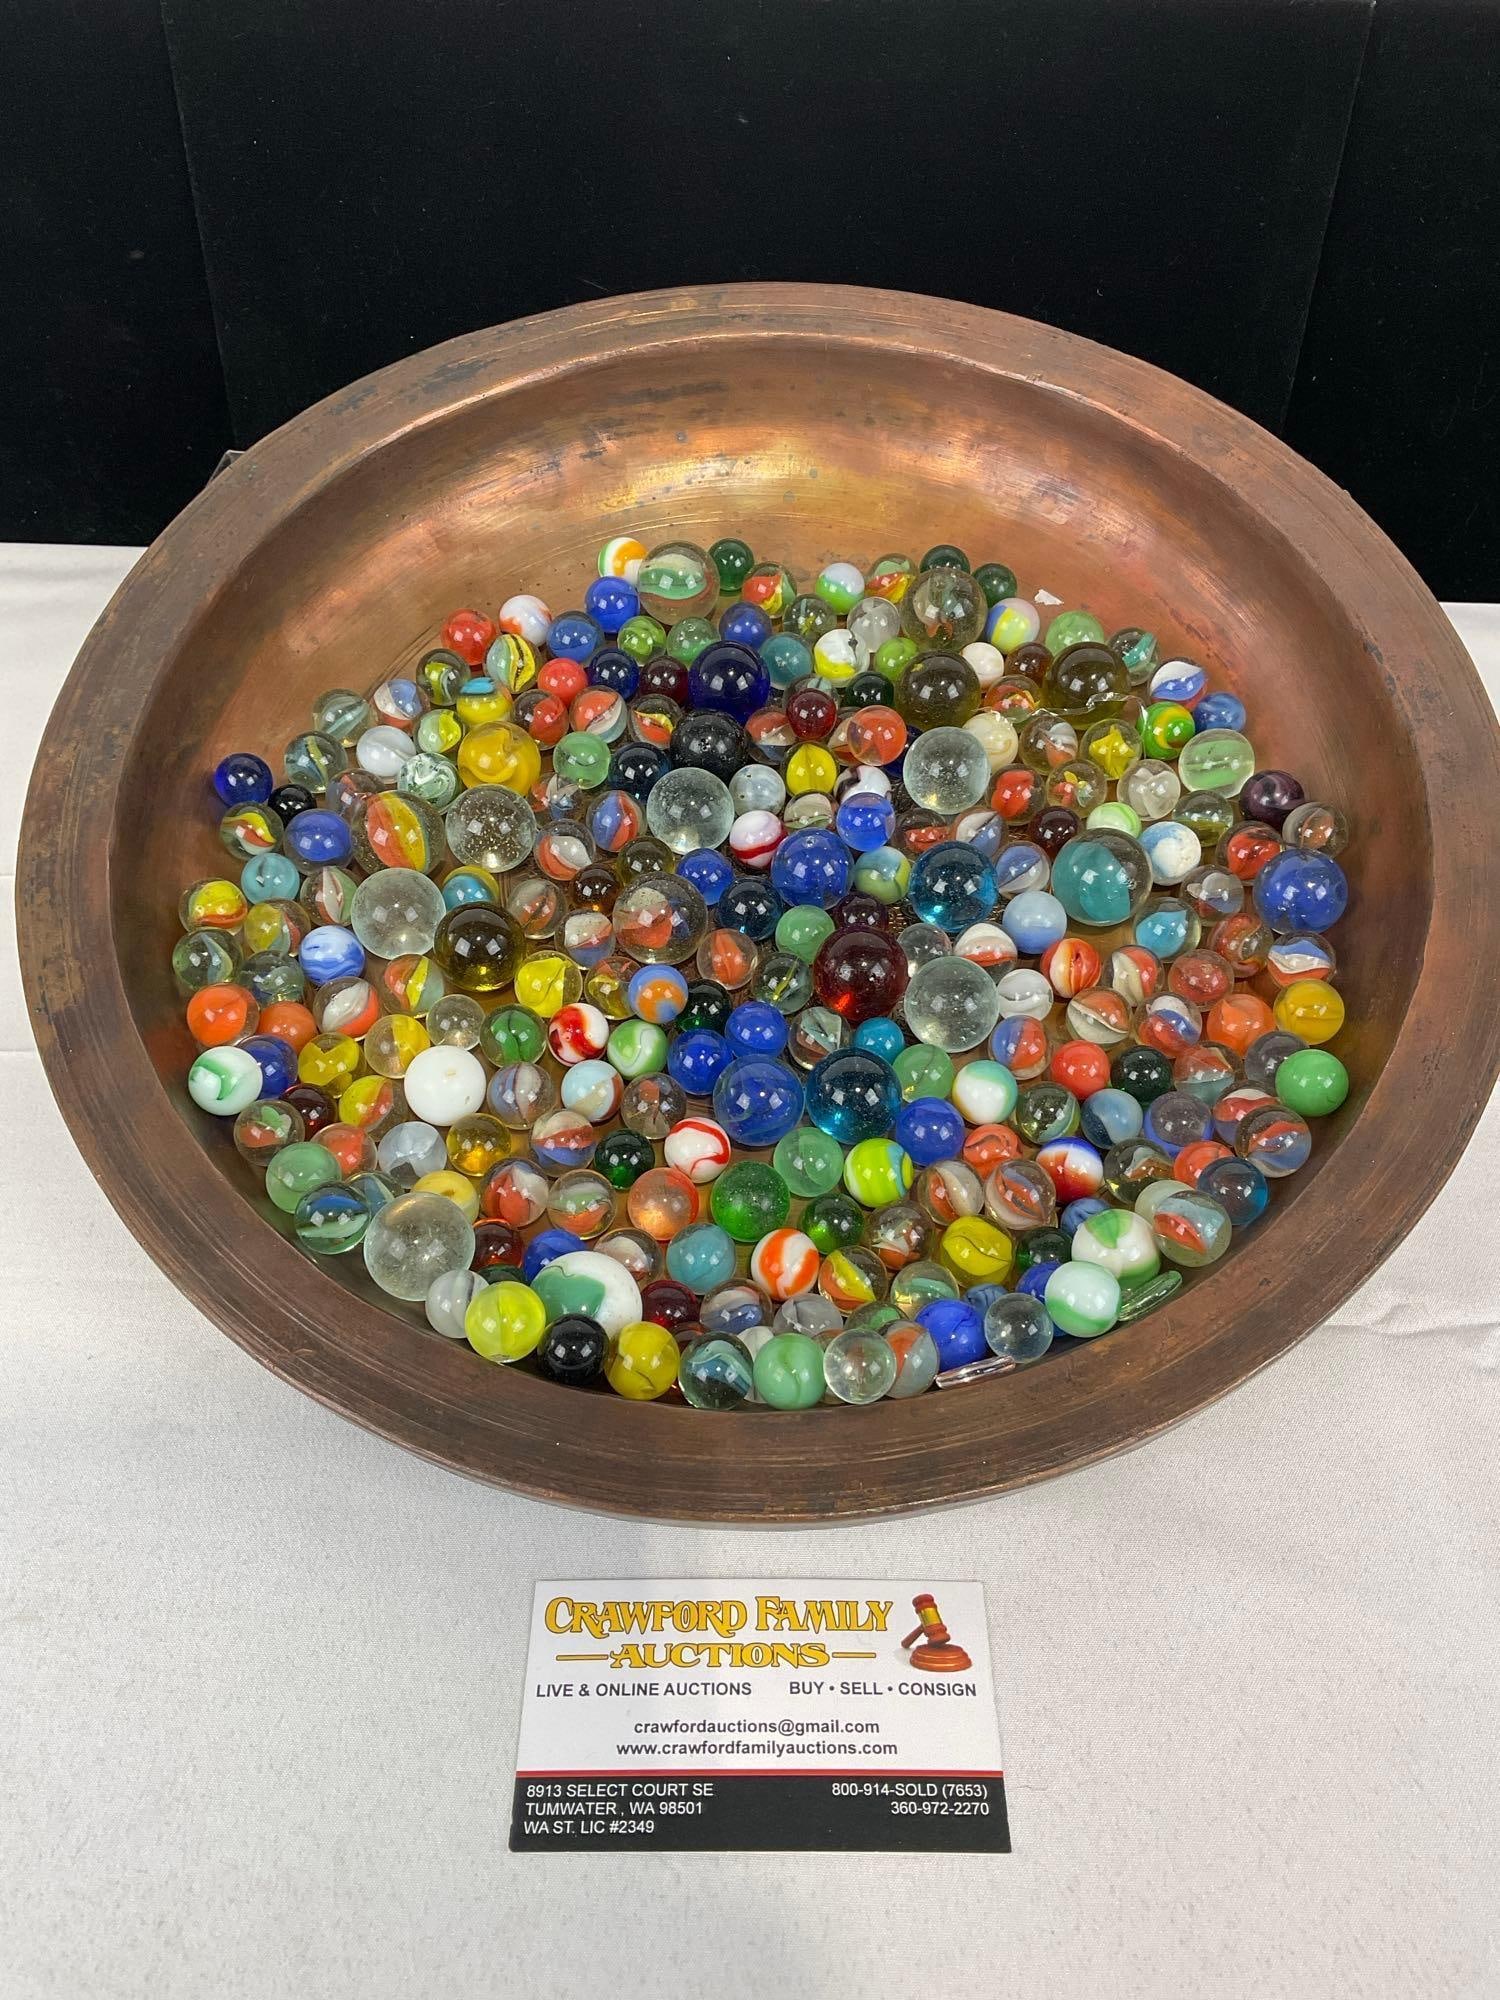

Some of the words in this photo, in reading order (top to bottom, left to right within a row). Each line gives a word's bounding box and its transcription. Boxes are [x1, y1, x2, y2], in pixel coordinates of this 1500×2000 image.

[545, 1596, 747, 1638] CRAWFORD
[756, 1596, 893, 1634] FAMILY
[610, 1642, 829, 1669] AUCTIONS
[537, 1683, 575, 1697] LIVE
[579, 1683, 590, 1696] &
[595, 1682, 659, 1697] ONLINE
[663, 1681, 752, 1696] AUCTIONS
[789, 1681, 825, 1696] BUY
[840, 1681, 882, 1696] SELL
[898, 1681, 976, 1697] CONSIGN
[634, 1719, 879, 1737] crawfordauctions@gmail.com
[617, 1740, 897, 1758] www.crawfordfamilyauctions.com
[526, 1784, 562, 1798] 8913
[566, 1783, 627, 1798] SELECT
[631, 1783, 688, 1797] COURT
[692, 1783, 714, 1797] SE
[832, 1782, 937, 1798] 800-914-SOLD
[942, 1783, 988, 1800] (7653)
[629, 1801, 655, 1815] WA
[659, 1801, 702, 1815] 98501
[891, 1801, 989, 1816] 360-972-2270
[524, 1820, 549, 1834] WA
[552, 1819, 576, 1834] ST.
[580, 1819, 605, 1834] LIC
[609, 1819, 654, 1834] #2349
